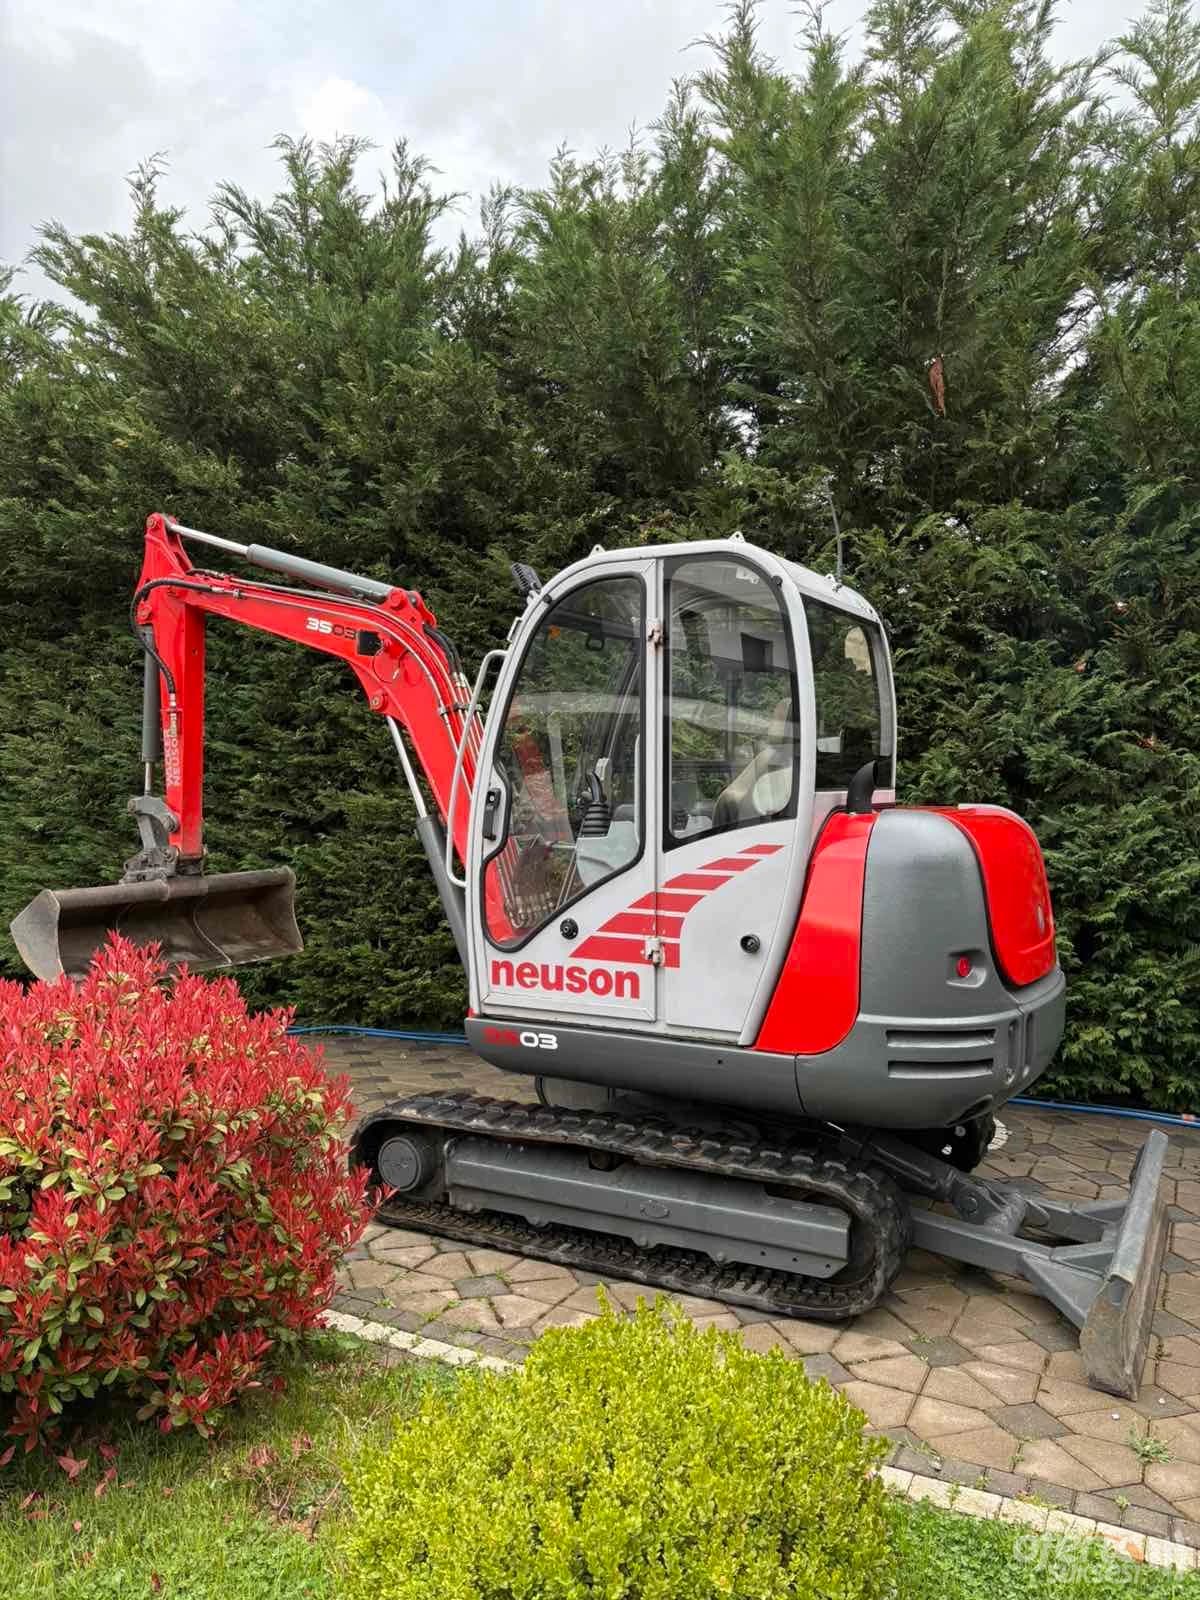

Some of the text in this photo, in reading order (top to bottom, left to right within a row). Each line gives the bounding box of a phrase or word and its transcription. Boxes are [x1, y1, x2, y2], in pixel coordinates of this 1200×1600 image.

[305, 617, 357, 640] 3503
[171, 737, 181, 786] NEUSO
[491, 960, 640, 999] neuson
